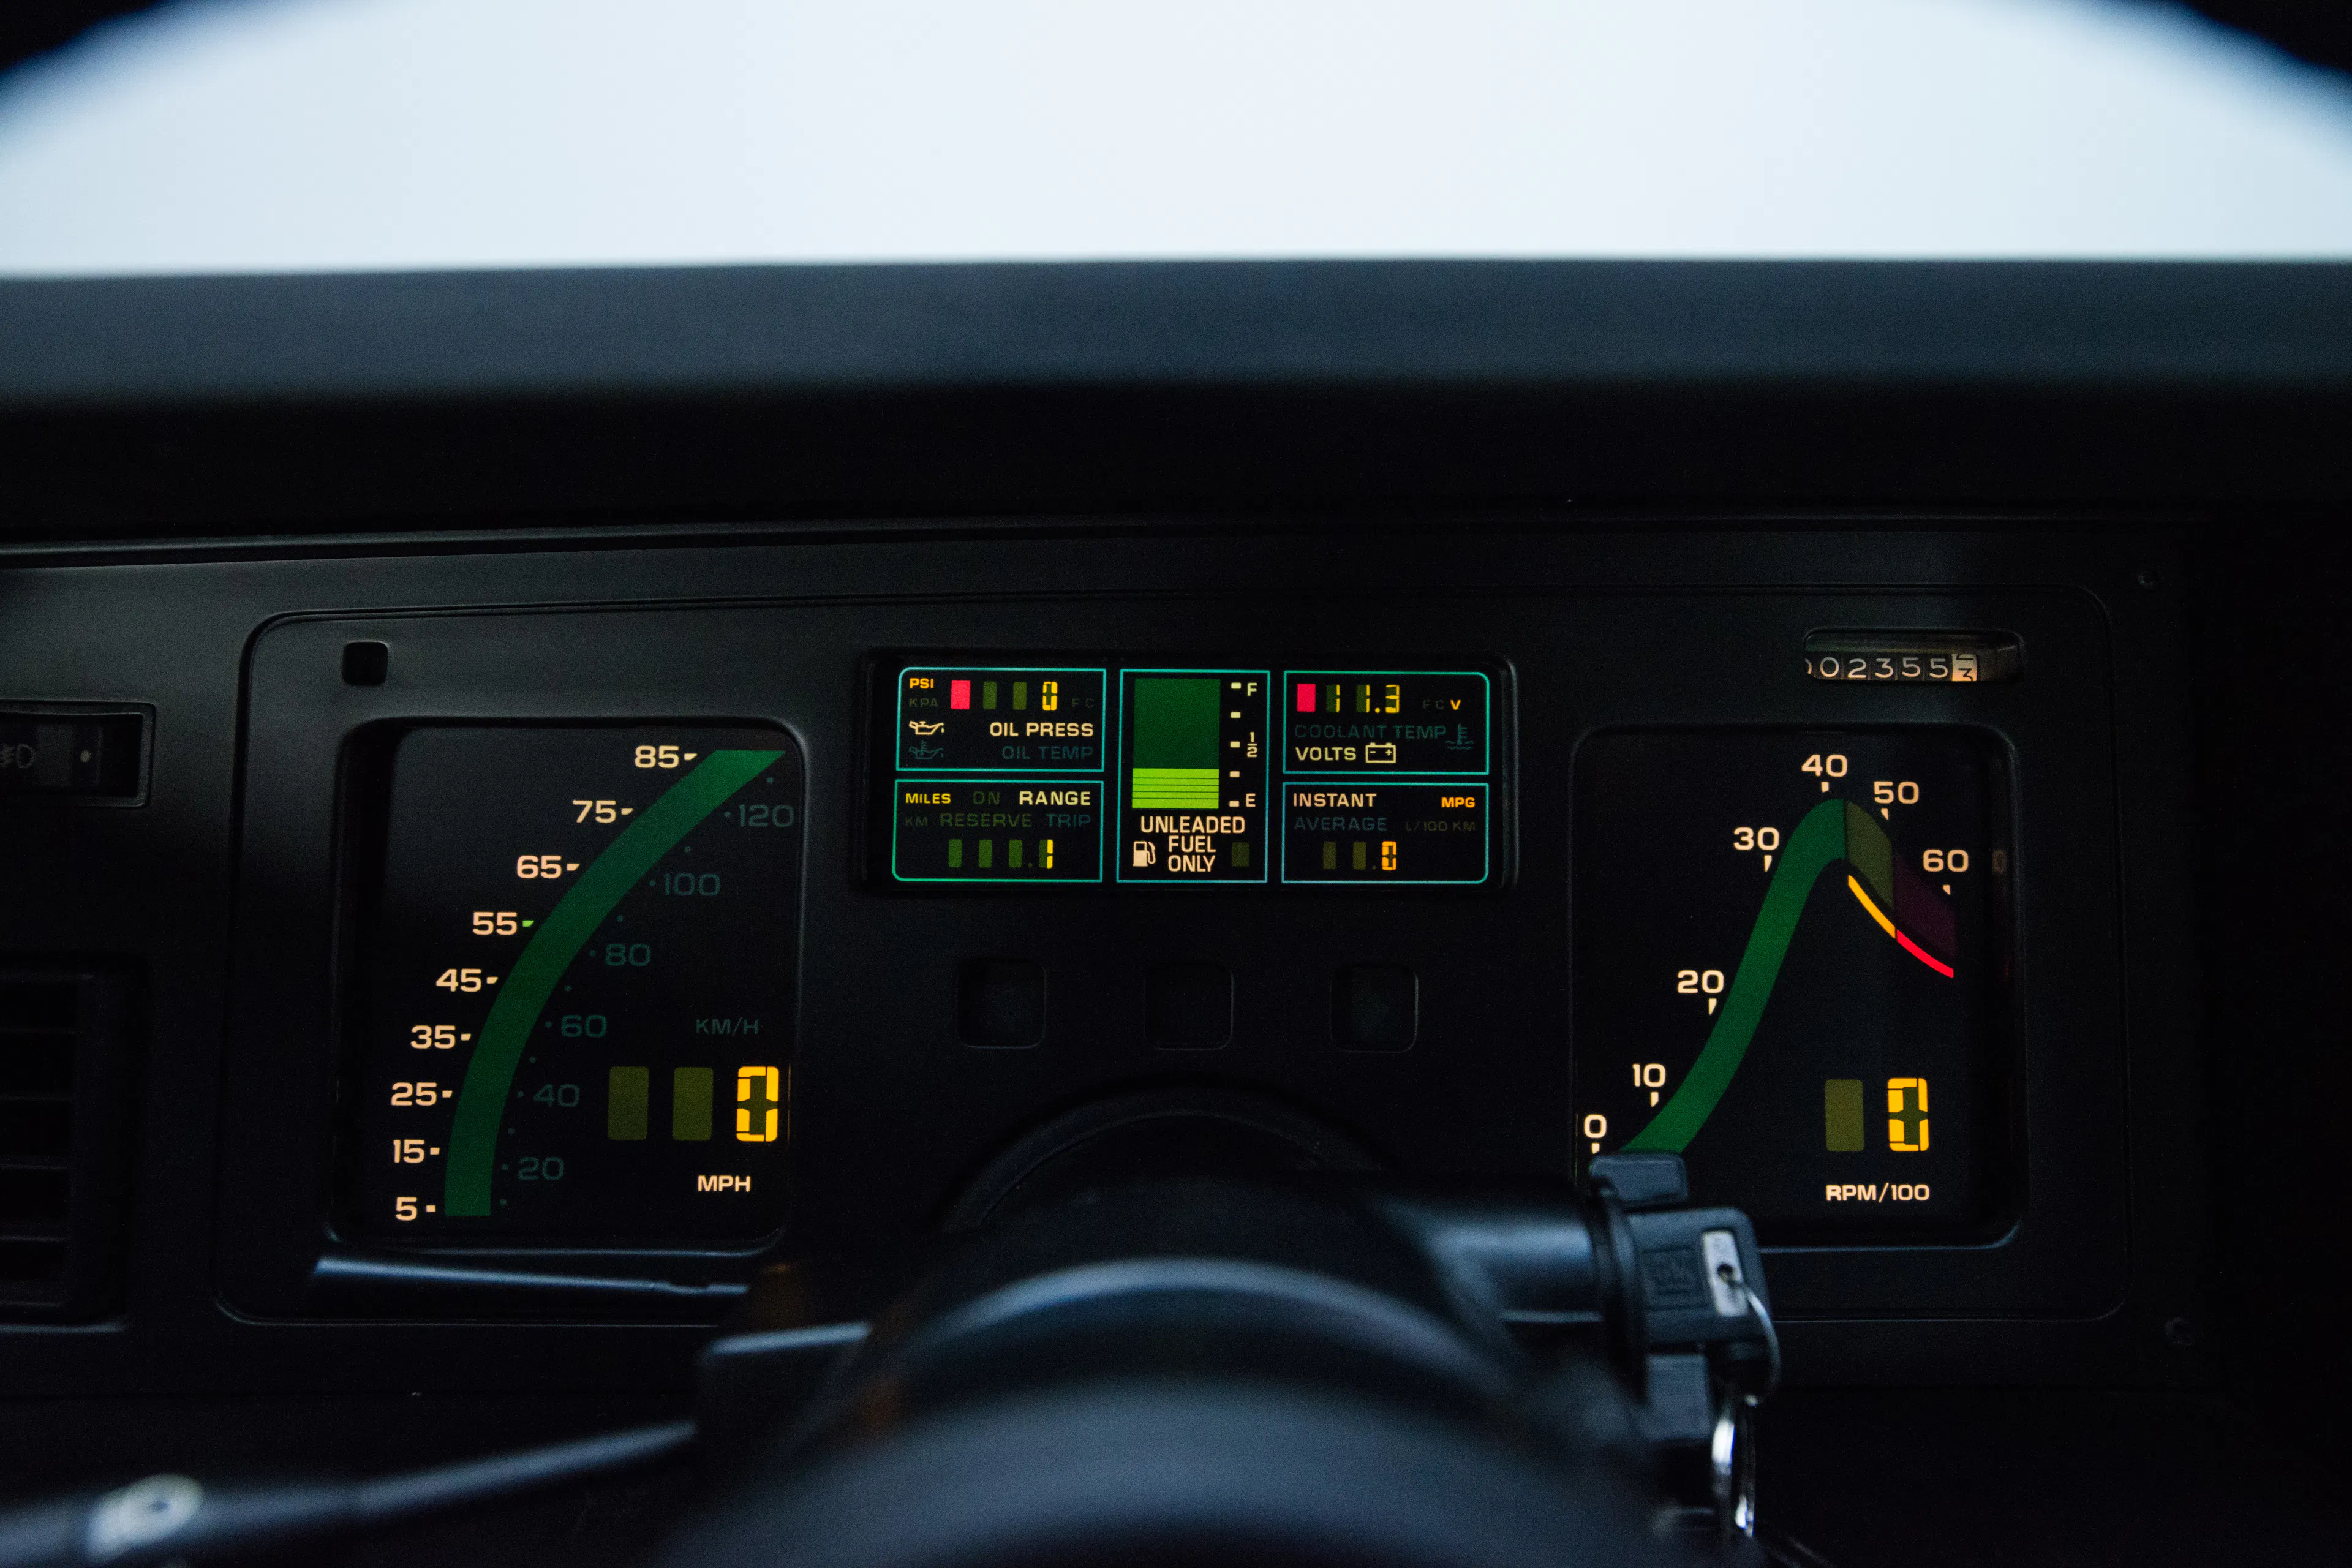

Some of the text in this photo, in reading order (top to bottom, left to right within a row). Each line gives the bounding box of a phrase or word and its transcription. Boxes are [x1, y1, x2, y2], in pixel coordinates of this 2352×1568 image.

[909, 678, 934, 689] PSI
[1246, 682, 1257, 696] F
[909, 698, 938, 708] KPA
[1042, 681, 1058, 711] 0
[990, 722, 1094, 737] OIL PRESS
[1294, 725, 1447, 739] COOLANT TEMP
[634, 745, 680, 769] 85
[1001, 745, 1093, 760] OIL TEMP
[1294, 747, 1357, 761] VOLTS
[1801, 754, 1849, 778] 40
[905, 793, 951, 804] MILES
[973, 791, 1000, 805] ON
[1019, 791, 1091, 806] RANGE
[1245, 793, 1256, 808] E
[1292, 793, 1378, 808] INSTANT
[1441, 796, 1476, 809] MPG
[1873, 781, 1920, 804] 50
[572, 799, 617, 824] 75
[737, 804, 794, 827] 120
[904, 816, 928, 827] KM
[940, 813, 1033, 827] RESERVE
[1046, 813, 1091, 828] TRIP
[1140, 816, 1246, 834] UNLEADED
[1294, 816, 1388, 832] AVERAGE
[1452, 821, 1476, 832] KM
[1168, 835, 1216, 853] FUEL
[1733, 827, 1780, 851] 30
[516, 855, 563, 878] 65
[1167, 855, 1216, 872] ONLY
[1381, 840, 1397, 871] 0
[1922, 849, 1969, 873] 60
[663, 873, 722, 897] 100
[472, 911, 518, 935] 55
[604, 943, 652, 967] 80
[435, 968, 483, 992] 45
[1676, 970, 1725, 994] 20
[410, 1025, 457, 1049] 35
[560, 1014, 608, 1038] 60
[695, 1017, 760, 1036] KM/H
[1632, 1063, 1667, 1088] 10
[390, 1082, 437, 1106] 25
[533, 1084, 581, 1107] 40
[736, 1065, 780, 1142] 0
[1887, 1077, 1929, 1152] 0
[1583, 1114, 1607, 1139] 0
[392, 1139, 426, 1164] 15
[517, 1156, 565, 1181] 20
[697, 1175, 751, 1193] MPH
[1825, 1183, 1931, 1203] RPM/100
[394, 1197, 418, 1222] 5
